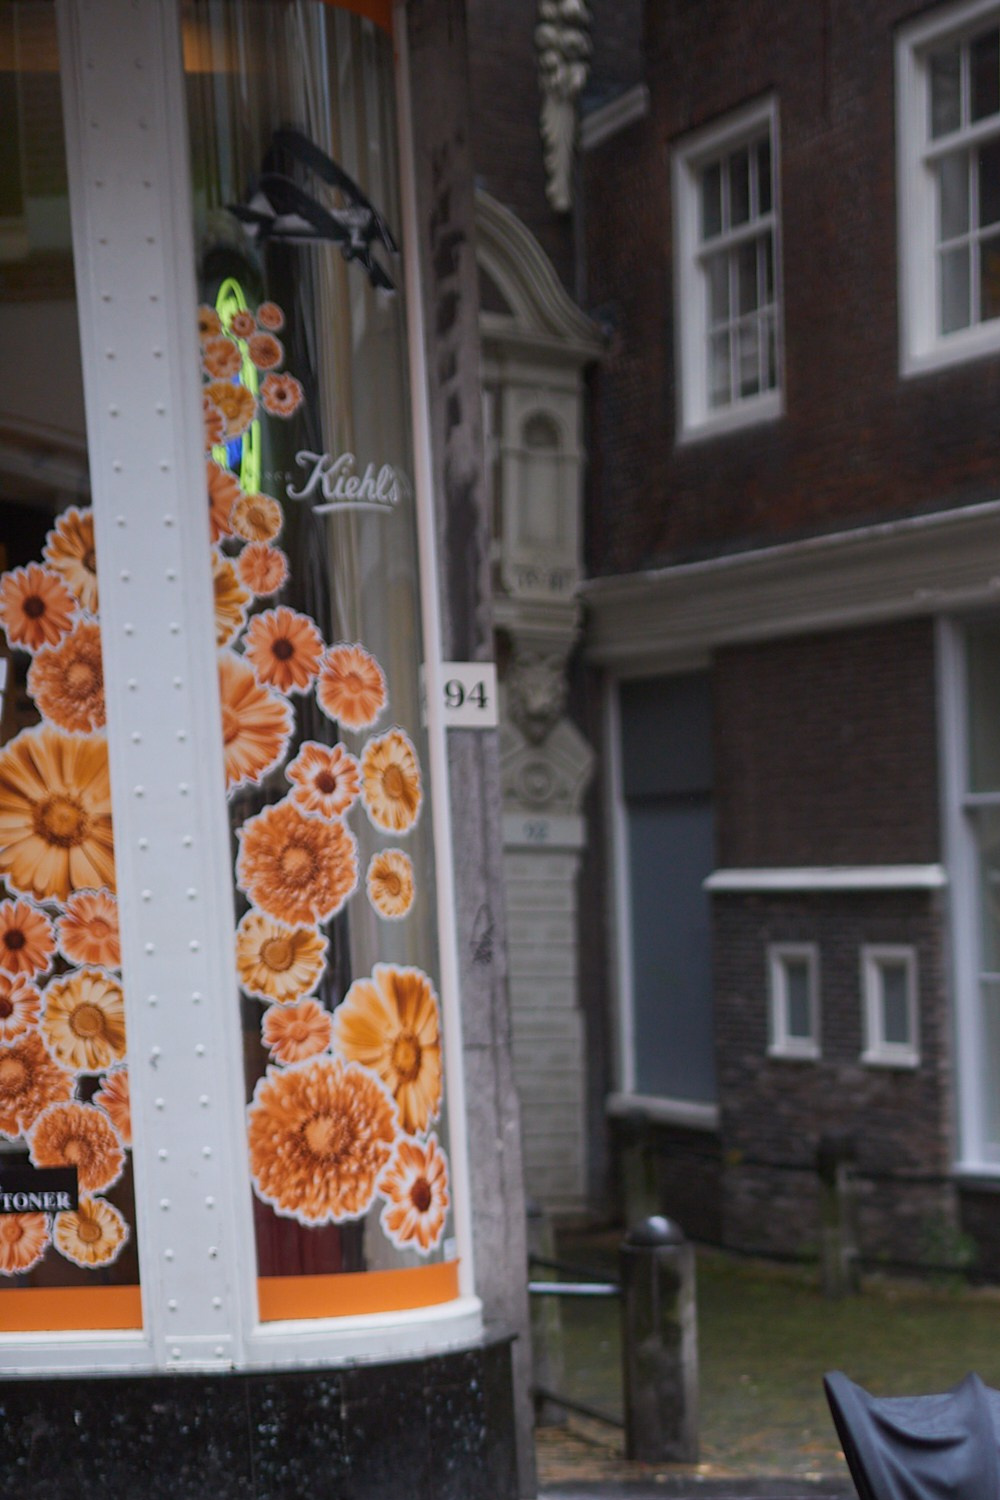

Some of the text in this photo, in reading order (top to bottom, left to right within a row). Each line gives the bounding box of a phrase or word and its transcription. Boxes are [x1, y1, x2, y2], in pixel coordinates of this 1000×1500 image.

[286, 451, 398, 502] Kiehl's
[444, 679, 488, 709] 94
[0, 1191, 71, 1212] TONER
